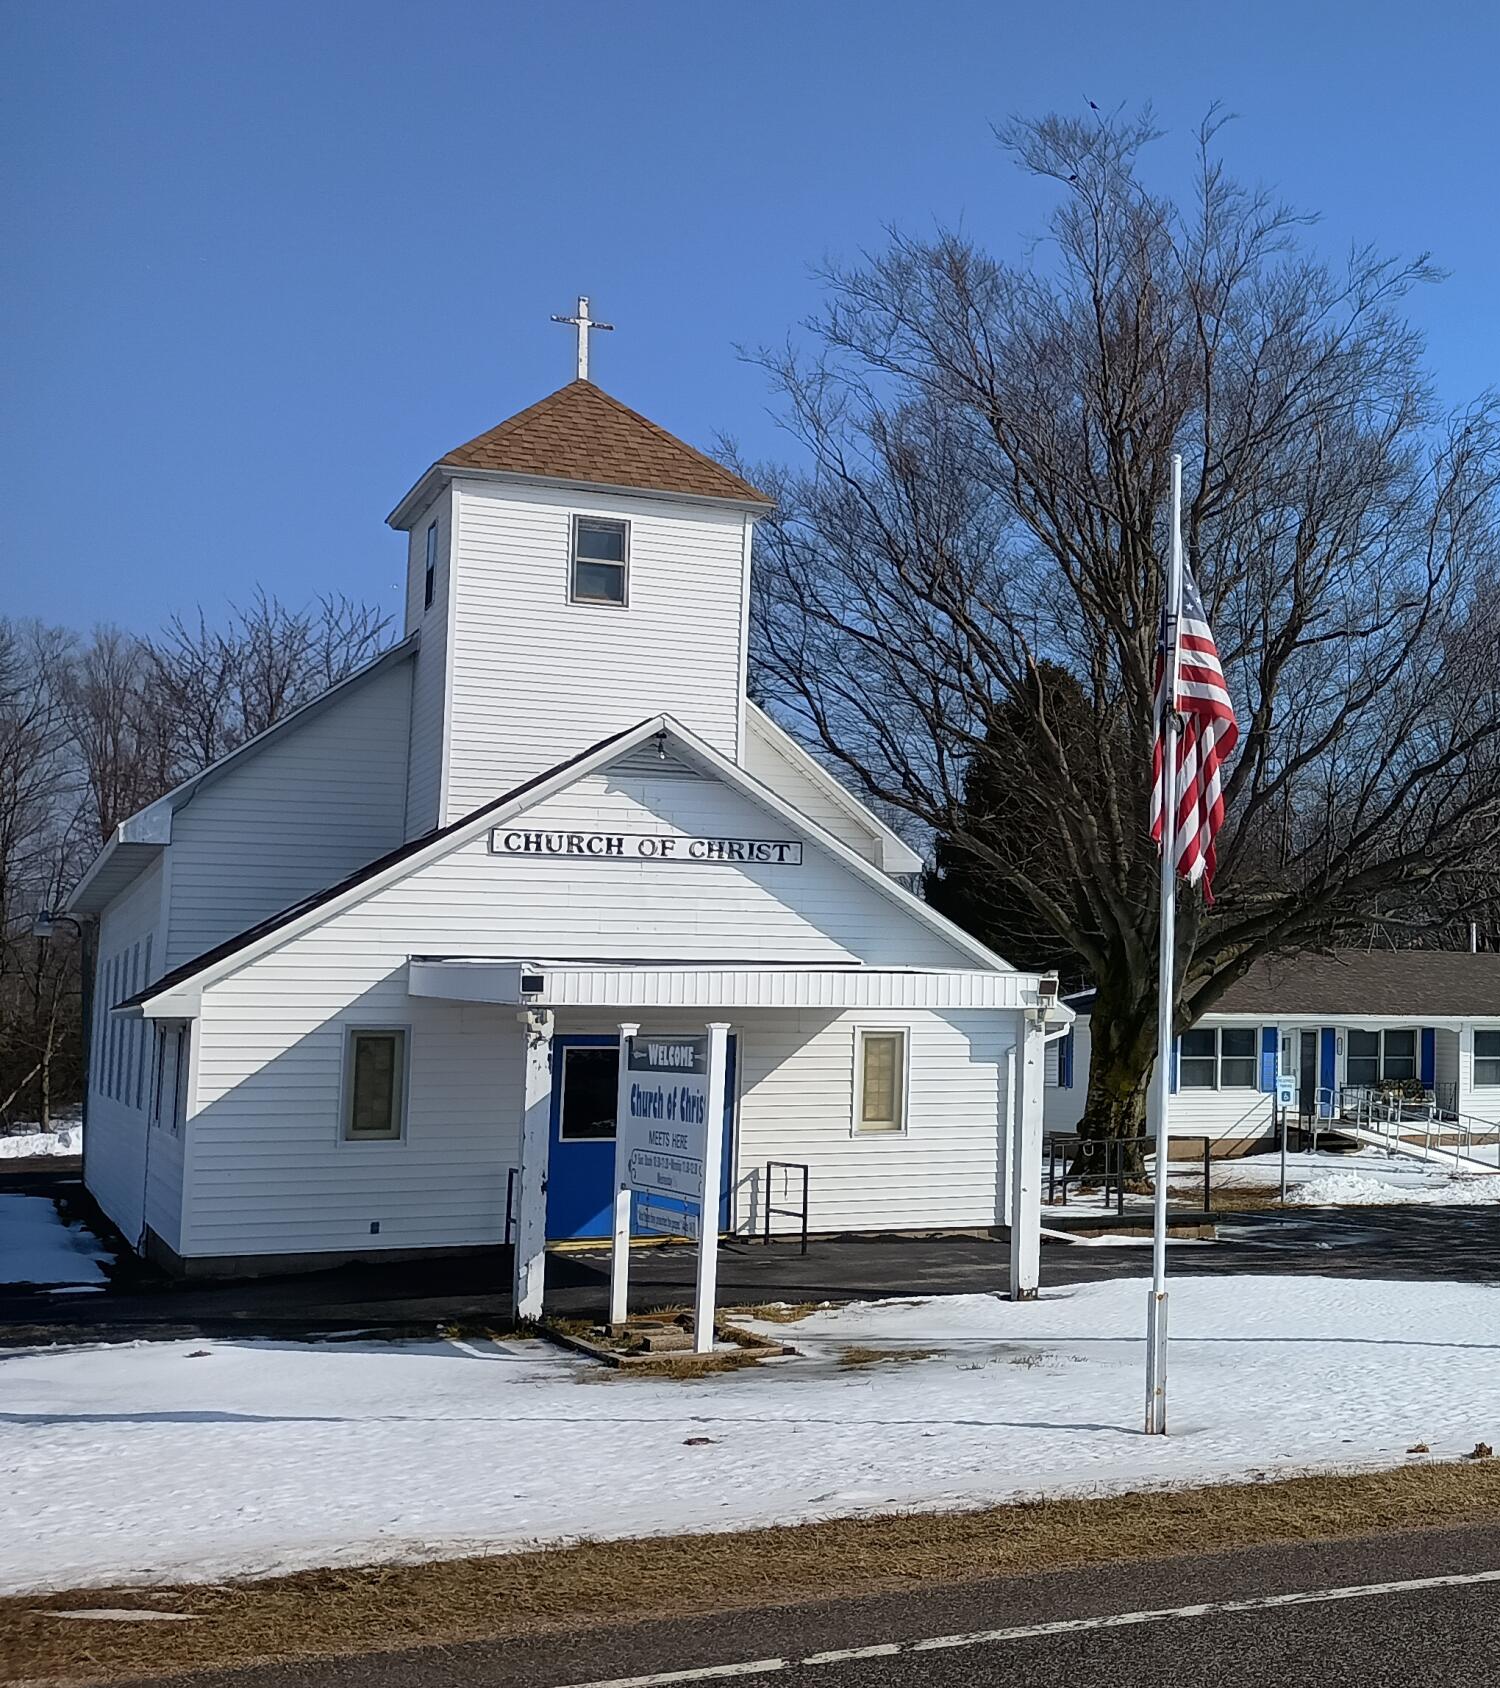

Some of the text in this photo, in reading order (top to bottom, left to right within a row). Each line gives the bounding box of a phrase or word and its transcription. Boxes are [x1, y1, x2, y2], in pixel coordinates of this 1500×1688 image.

[504, 832, 791, 862] CHURCH OF CHRIST
[648, 1044, 694, 1067] WELCOME
[630, 1083, 706, 1124] Church of Chris
[648, 1130, 688, 1150] MEETS HERE
